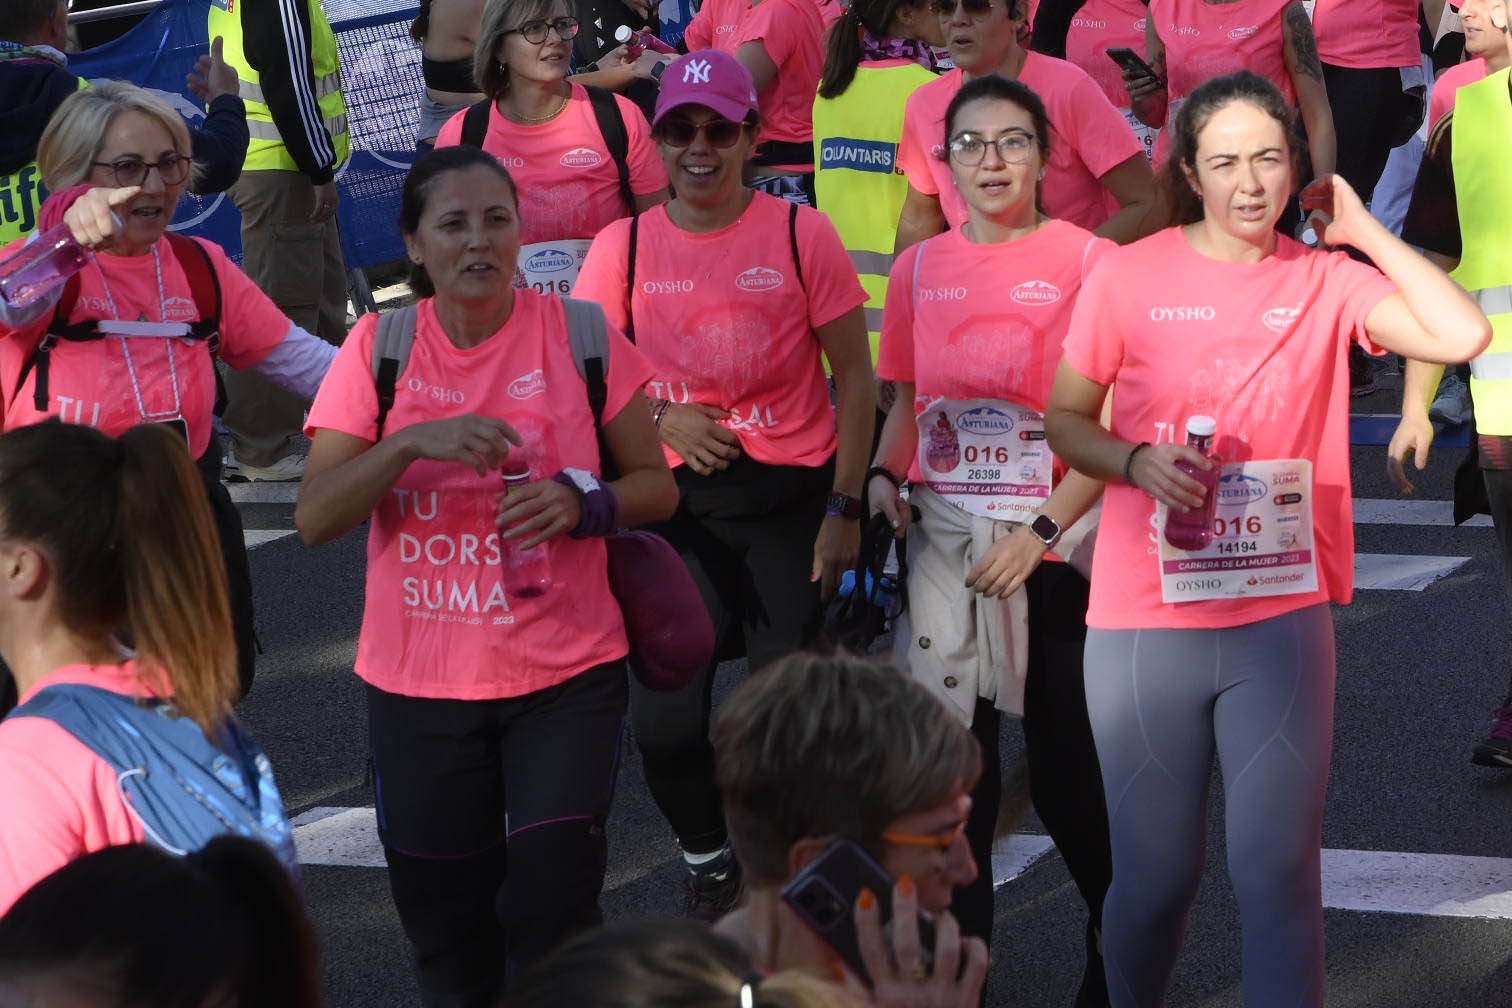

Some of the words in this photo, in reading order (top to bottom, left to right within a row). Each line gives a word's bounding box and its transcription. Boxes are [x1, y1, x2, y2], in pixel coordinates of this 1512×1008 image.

[683, 58, 712, 84] NY
[527, 258, 572, 271] ASTURIANA
[643, 279, 694, 294] OYSHO
[737, 276, 782, 289] ASTURIANA
[1151, 306, 1216, 321] OYSHO
[651, 380, 690, 404] TU
[961, 418, 1009, 430] ASTURIANA
[964, 445, 1009, 464] 016
[968, 468, 1001, 481] 26398
[1272, 476, 1300, 486] SUMA
[392, 488, 438, 521] TU
[1213, 515, 1262, 537] 016
[400, 533, 501, 566] DORS
[1217, 541, 1258, 555] 14194
[1178, 559, 1220, 571] CARRERA
[1222, 559, 1234, 569] DE
[1235, 558, 1247, 568] LA
[1249, 556, 1279, 567] MUJER
[1176, 578, 1222, 592] OYSHO
[1258, 572, 1305, 587] Santander
[403, 576, 511, 613] SUMA
[493, 614, 515, 625] 2023
